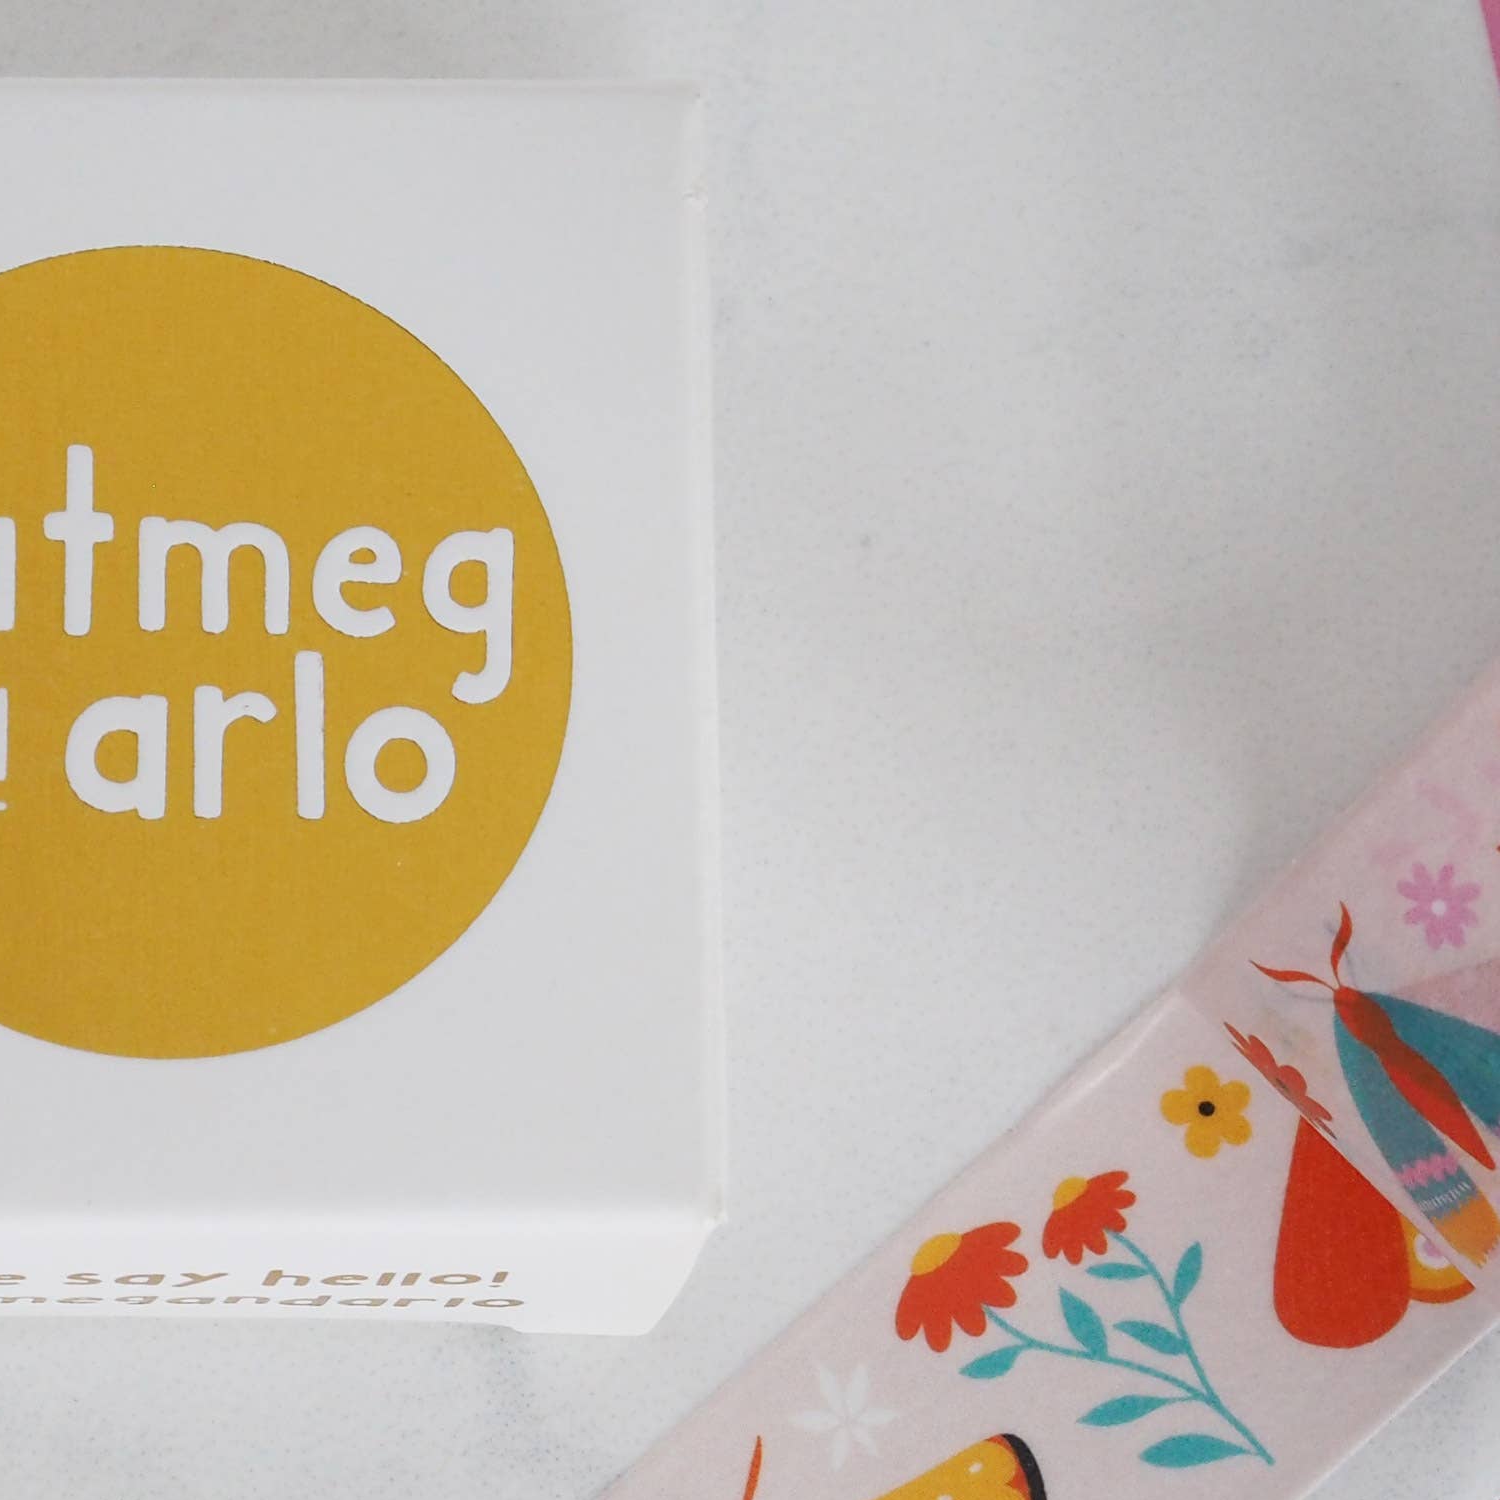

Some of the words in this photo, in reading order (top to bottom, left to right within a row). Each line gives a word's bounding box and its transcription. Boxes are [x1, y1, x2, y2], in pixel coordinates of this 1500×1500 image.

[63, 650, 458, 825] arlo
[62, 1272, 230, 1288] say
[261, 1269, 511, 1288] hello!
